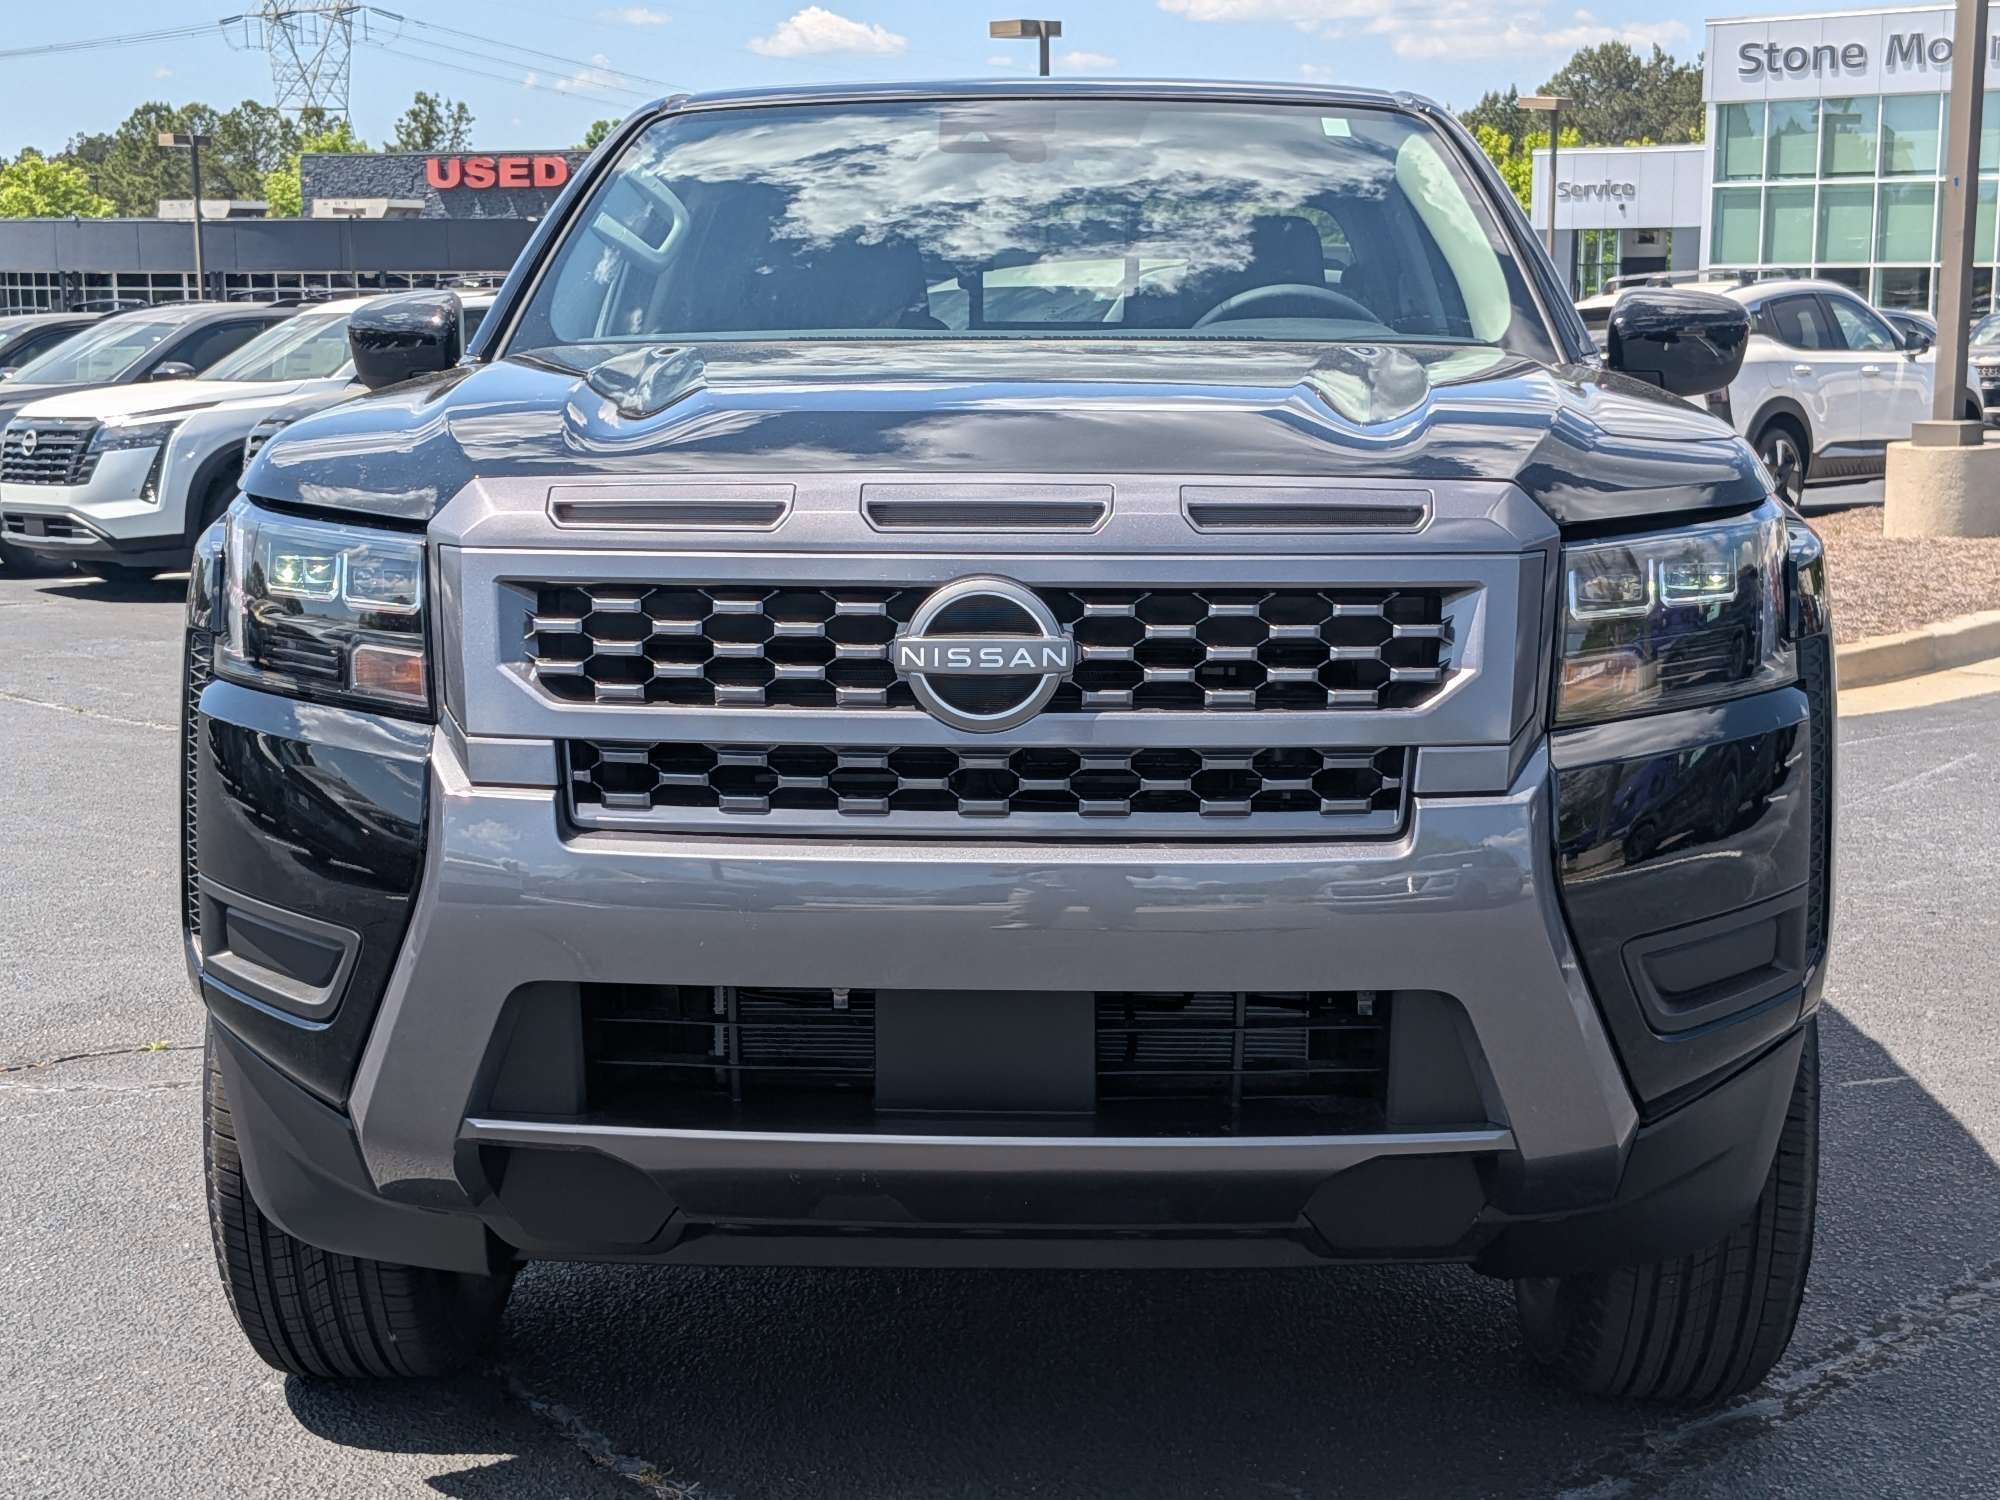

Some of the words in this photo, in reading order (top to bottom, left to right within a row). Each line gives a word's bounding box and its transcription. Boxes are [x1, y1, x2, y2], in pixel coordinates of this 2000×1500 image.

[1738, 42, 1866, 75] Stone
[426, 155, 568, 189] USED
[1557, 179, 1635, 200] Service
[901, 647, 1067, 668] NISSAN
